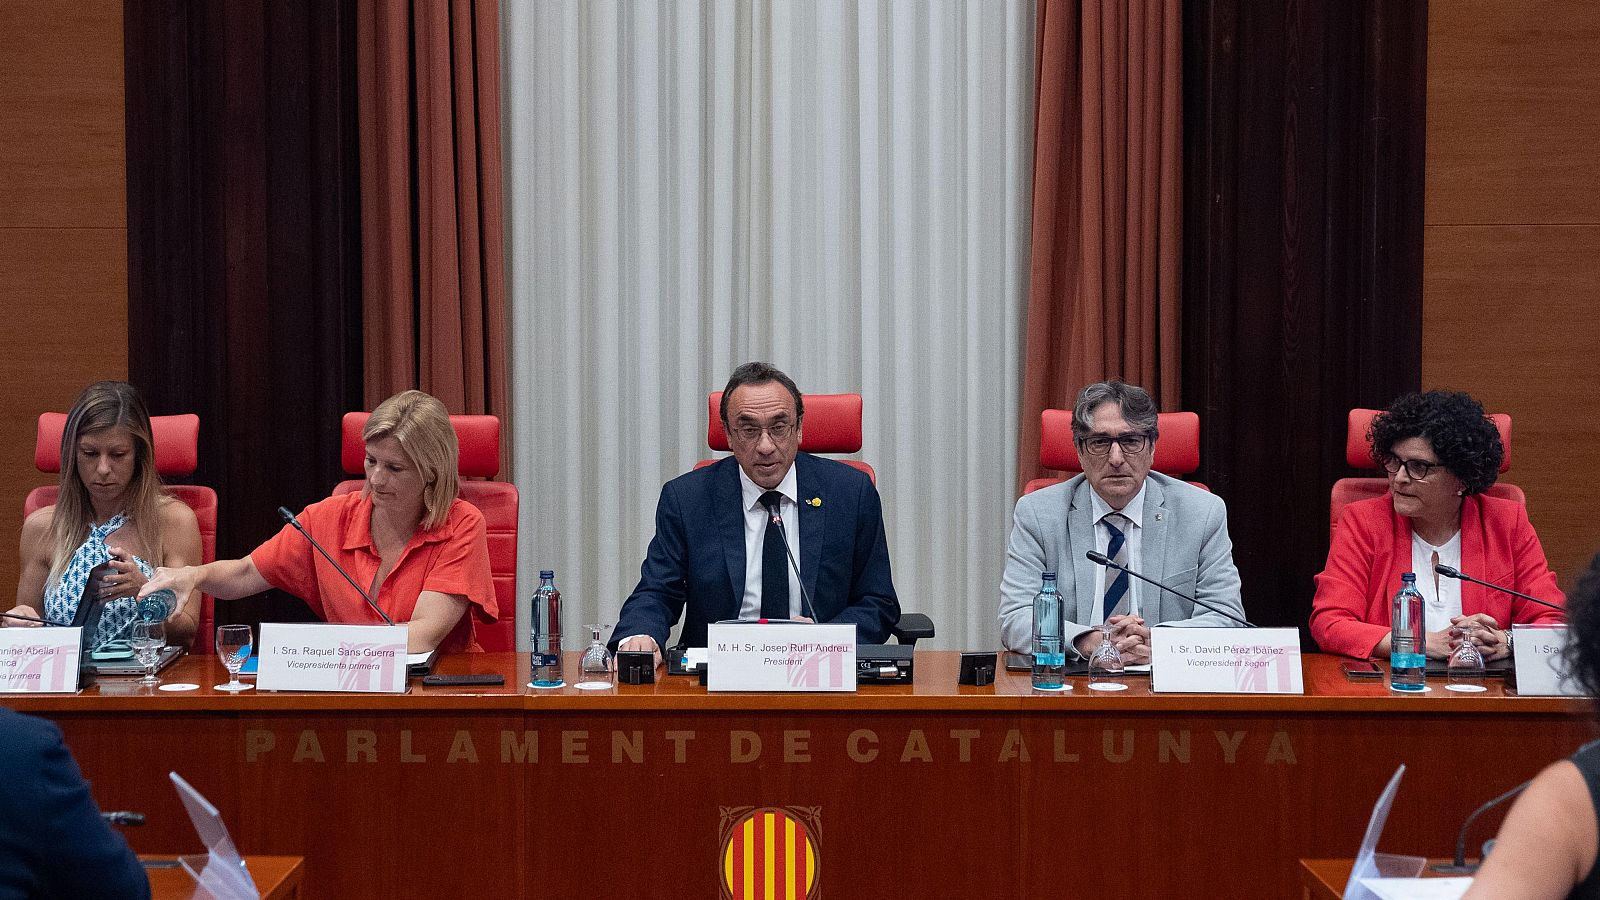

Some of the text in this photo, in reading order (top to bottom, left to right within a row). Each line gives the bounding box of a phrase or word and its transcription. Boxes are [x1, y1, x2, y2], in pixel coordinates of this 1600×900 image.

[25, 646, 54, 655] Abella
[281, 646, 300, 655] Sra.
[302, 647, 335, 657] Raquel
[337, 648, 361, 656] Sans
[363, 648, 395, 657] Guerra
[717, 643, 729, 652] M.
[731, 643, 741, 652] H.
[744, 643, 758, 652] Sr.
[760, 643, 787, 654] Josep
[790, 643, 808, 652] Rull
[815, 643, 848, 652] Andreu
[1179, 645, 1192, 654] Sr.
[1194, 645, 1221, 654] David
[1223, 645, 1250, 654] Pérez
[1253, 645, 1284, 655] Ibáñez
[287, 661, 380, 671] Vicepresidenta primera
[763, 657, 803, 666] President
[1186, 658, 1270, 669] Vicepresident segon
[8, 673, 41, 681] primera
[245, 728, 1298, 765] PARLAMENT DE CATALUNYA
